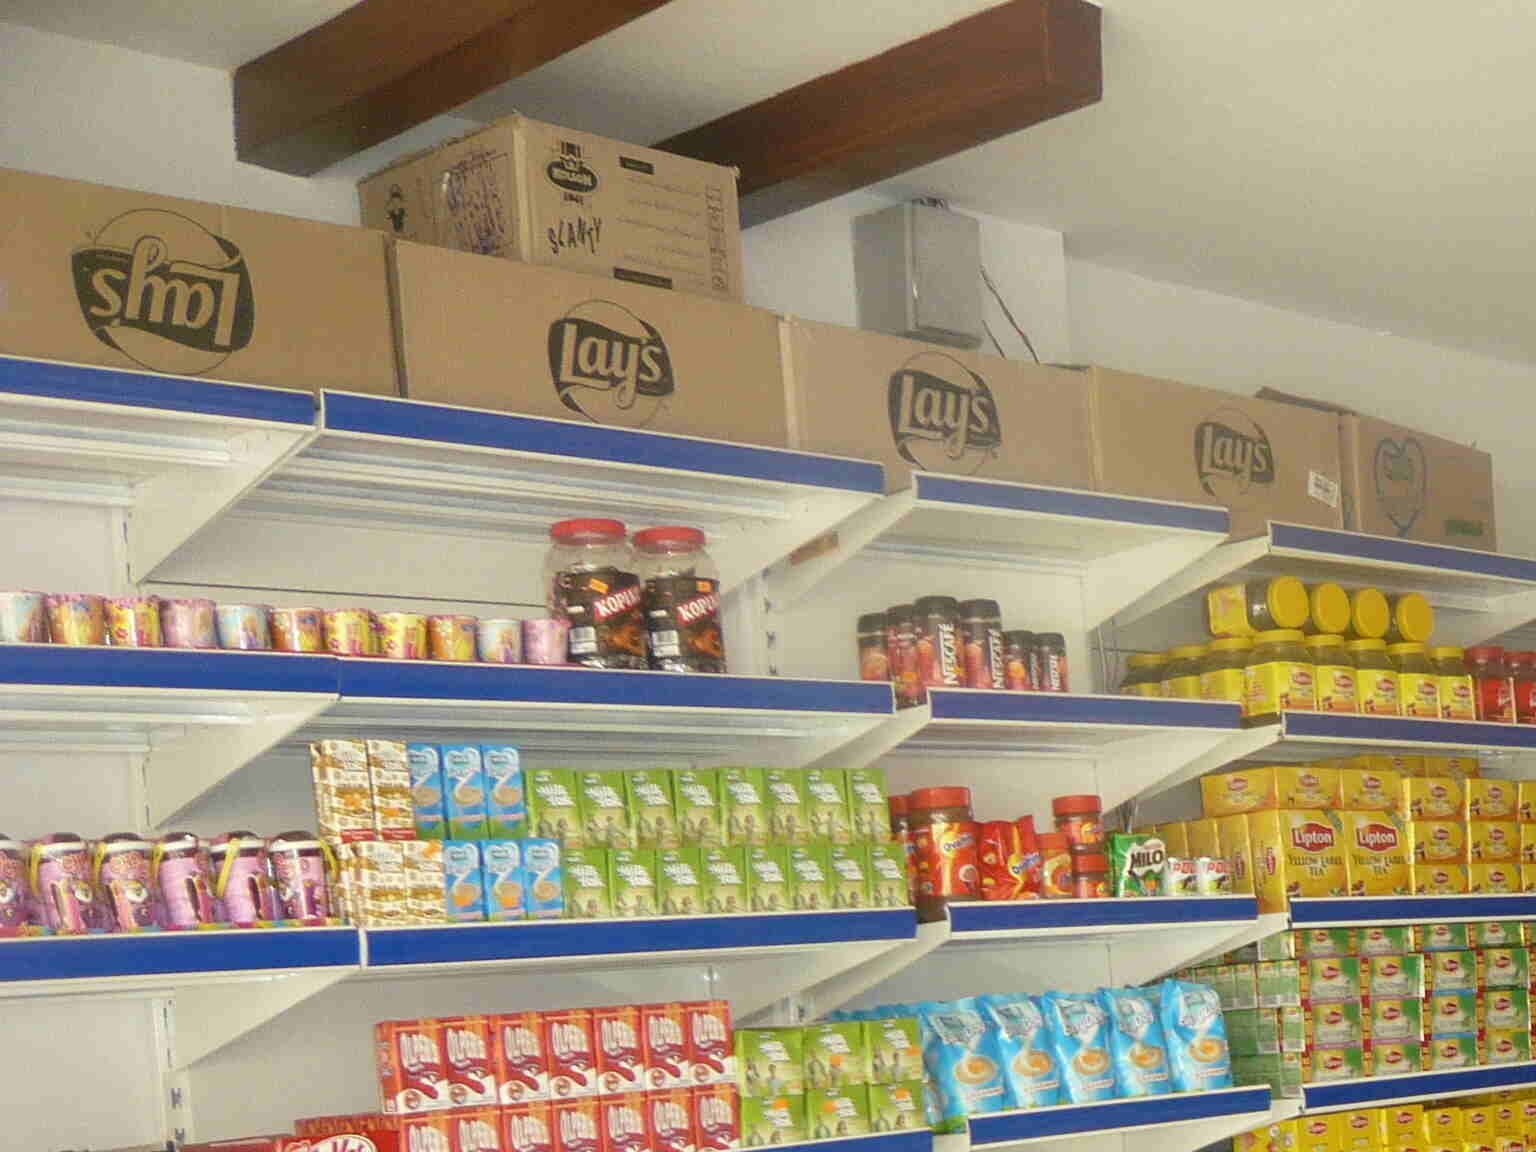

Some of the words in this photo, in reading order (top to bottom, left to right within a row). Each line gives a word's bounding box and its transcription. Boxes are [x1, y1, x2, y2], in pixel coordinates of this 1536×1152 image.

[1294, 830, 1332, 848] Lipton
[1359, 830, 1395, 848] Lipton
[1128, 849, 1165, 869] MILO
